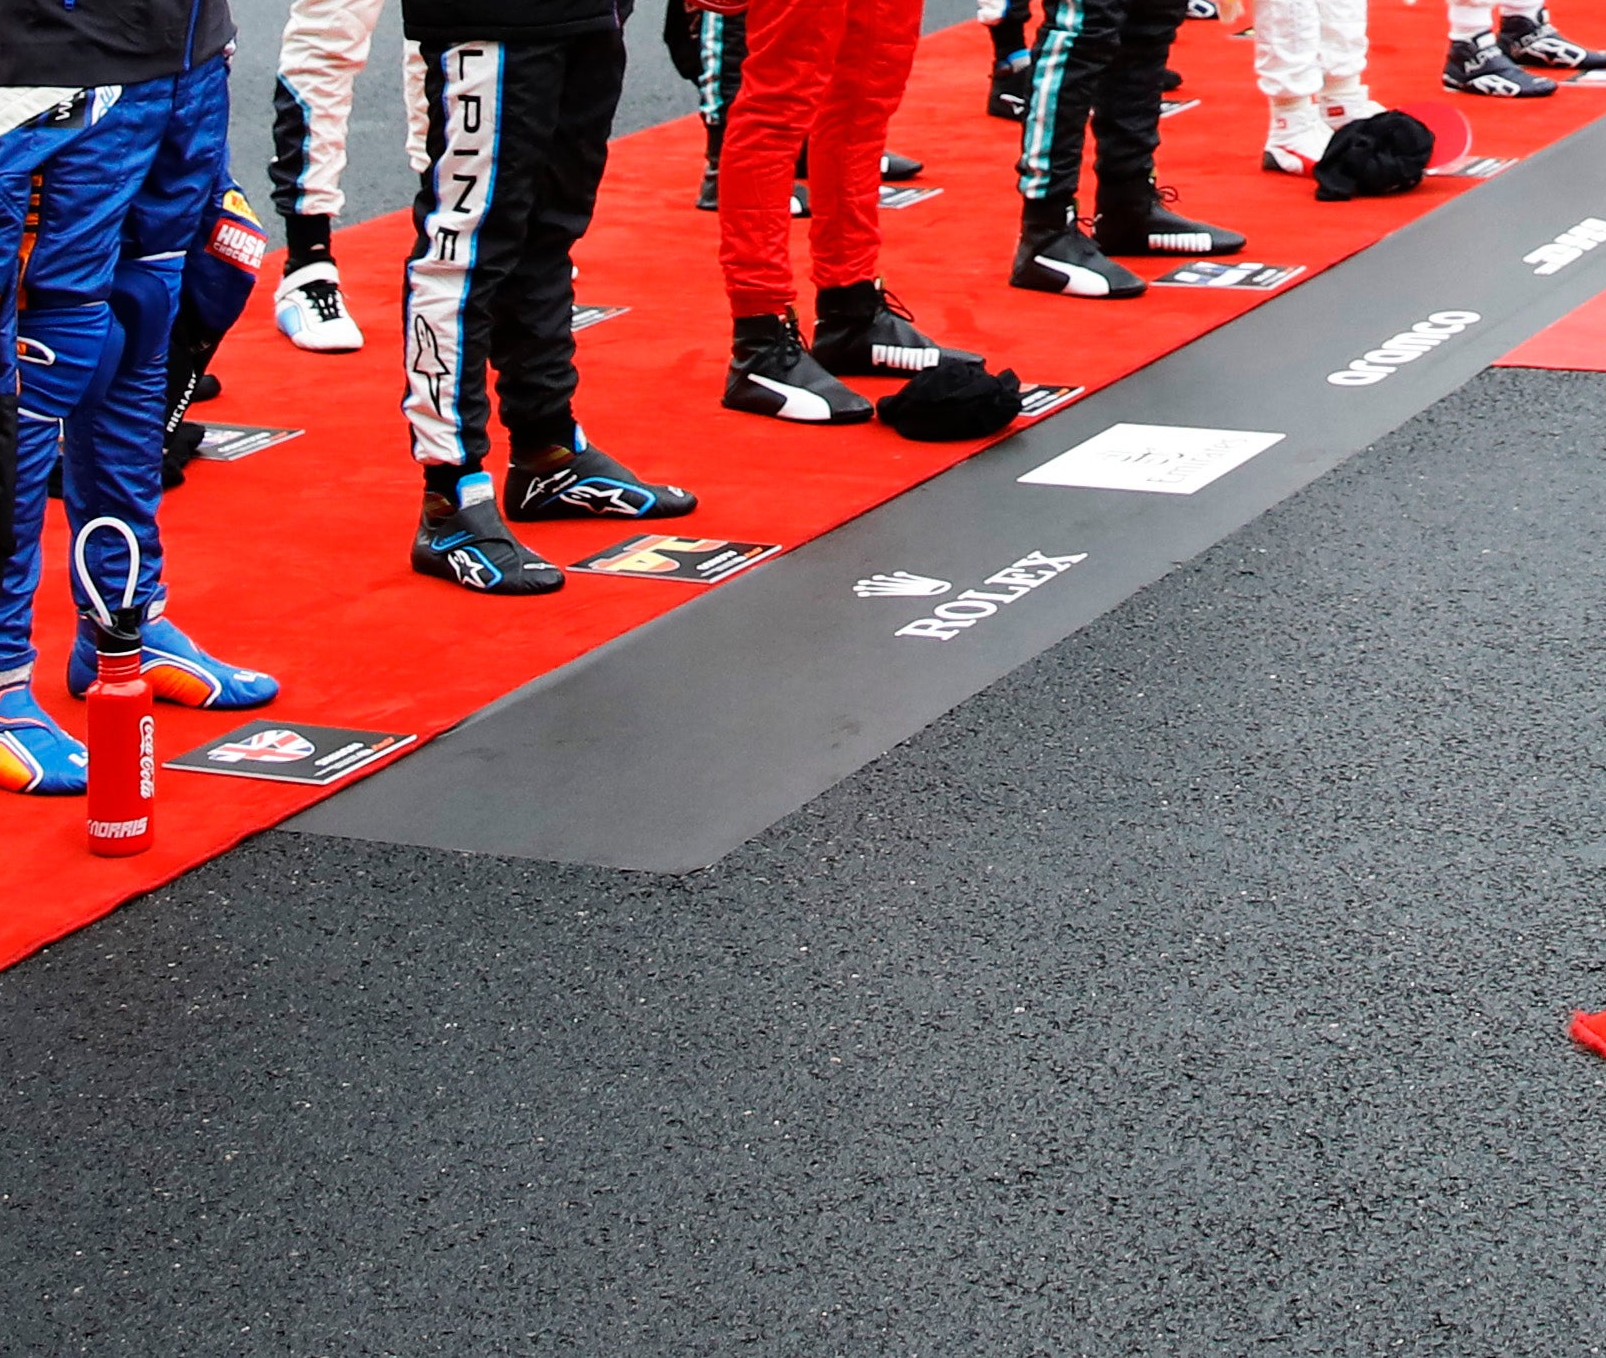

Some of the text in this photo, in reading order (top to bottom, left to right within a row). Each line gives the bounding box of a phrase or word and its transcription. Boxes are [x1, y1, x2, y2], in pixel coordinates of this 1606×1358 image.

[434, 49, 485, 262] LPINE
[1327, 310, 1482, 386] aramco
[895, 550, 1089, 641] ROLEX
